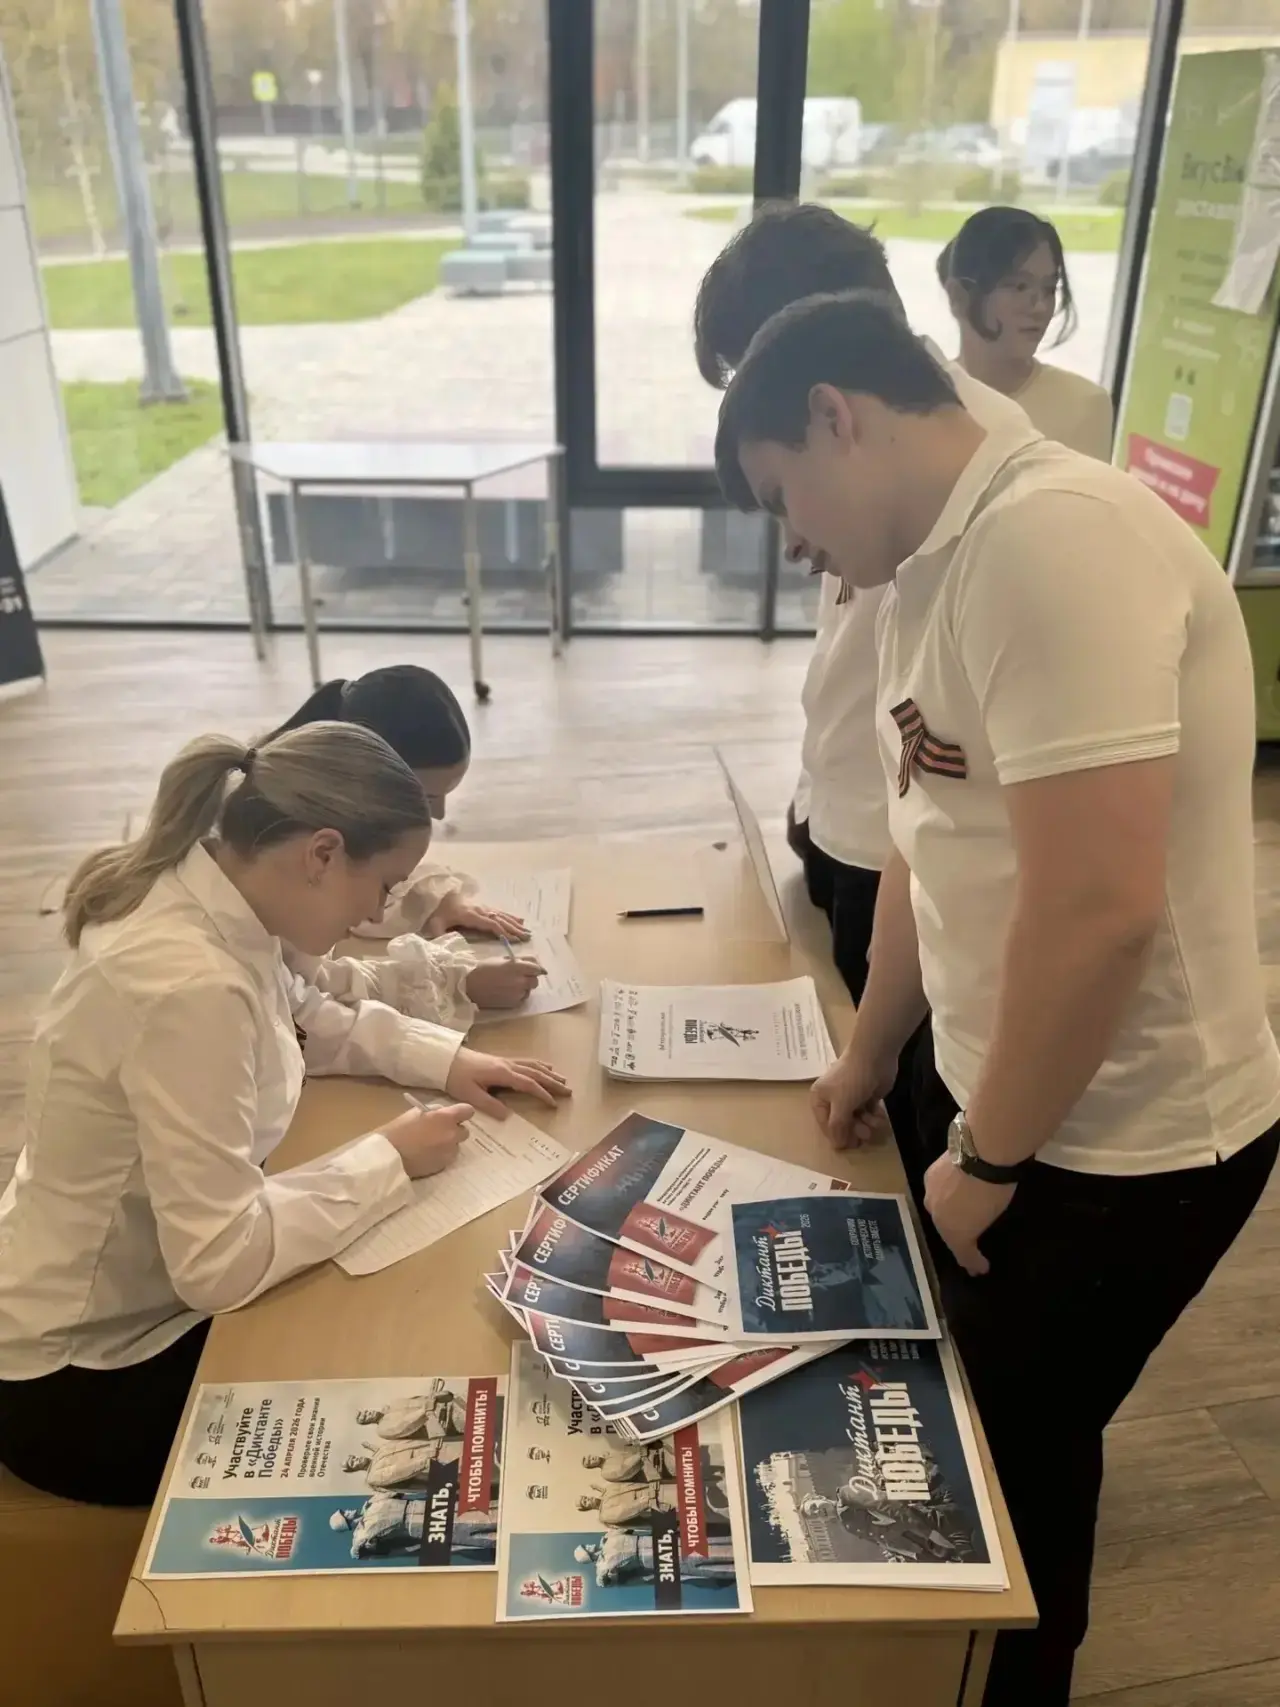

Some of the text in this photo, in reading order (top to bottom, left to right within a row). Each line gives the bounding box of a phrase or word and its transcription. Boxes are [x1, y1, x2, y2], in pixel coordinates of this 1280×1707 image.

[557, 1144, 625, 1206] СЕРТИФИКАТ
[533, 1214, 569, 1264] СЕРТИФ
[752, 1236, 776, 1311] Диктант
[774, 1230, 813, 1311] ПОБЕДЫ
[222, 1407, 254, 1480] Участвуйте
[244, 1399, 273, 1479] в «Диктанте
[258, 1418, 284, 1478] Победы»
[284, 1438, 296, 1467] АПРЕЛЯ
[289, 1418, 301, 1437] 2026
[297, 1397, 320, 1478] Проверьте свои знания
[309, 1417, 326, 1478] военной истории
[467, 1390, 488, 1502] ЧТОБЫ ПОМНИТЬ!
[591, 1426, 602, 1434] в
[838, 1383, 879, 1501] Диктант
[869, 1382, 932, 1500] ПОБЕДЫ
[280, 1467, 290, 1478] 24
[317, 1440, 331, 1478] Отечества
[428, 1482, 453, 1544] ЗНАТЬ,
[682, 1447, 699, 1547] ЧТОБЫ ПОМНИТЬ!
[276, 1517, 297, 1558] ПОБЕДЫ
[658, 1529, 675, 1582] ЗНАТЬ,
